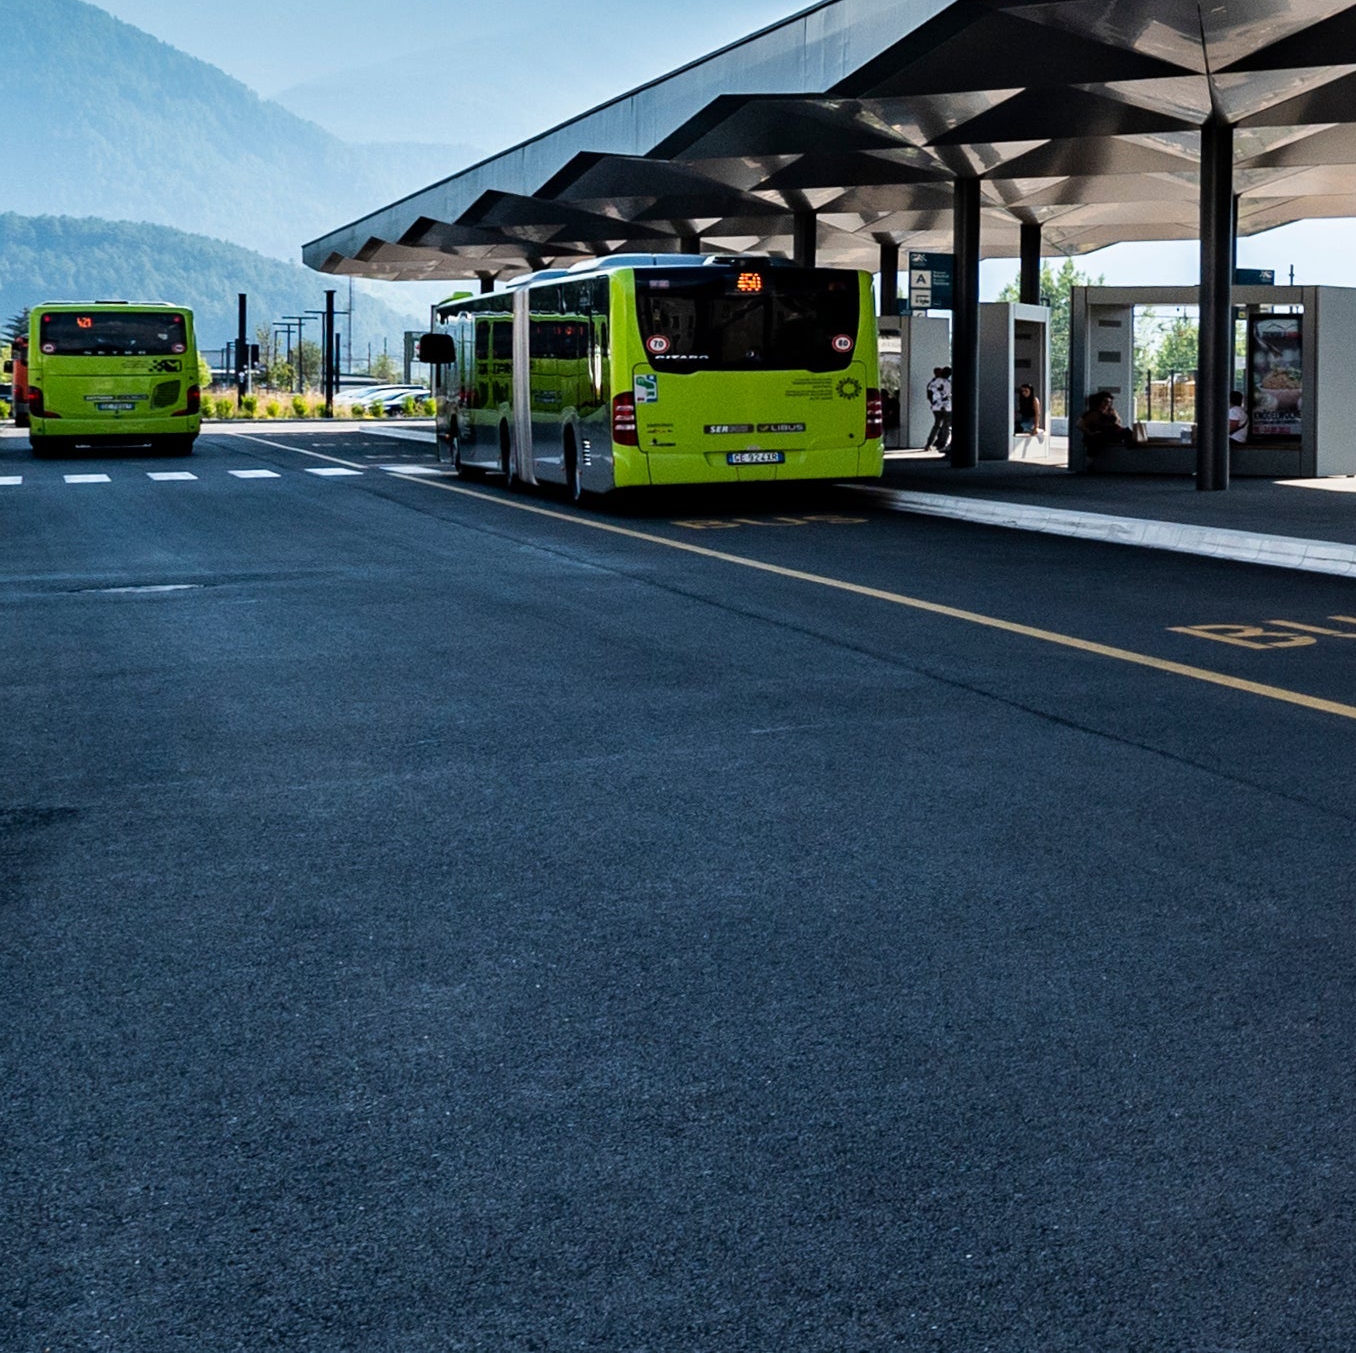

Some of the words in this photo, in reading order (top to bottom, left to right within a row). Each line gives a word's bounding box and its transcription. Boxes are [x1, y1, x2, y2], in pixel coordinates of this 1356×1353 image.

[737, 273, 762, 292] 450
[916, 273, 926, 284] A
[653, 339, 664, 348] 70
[771, 423, 804, 432] LIBUS
